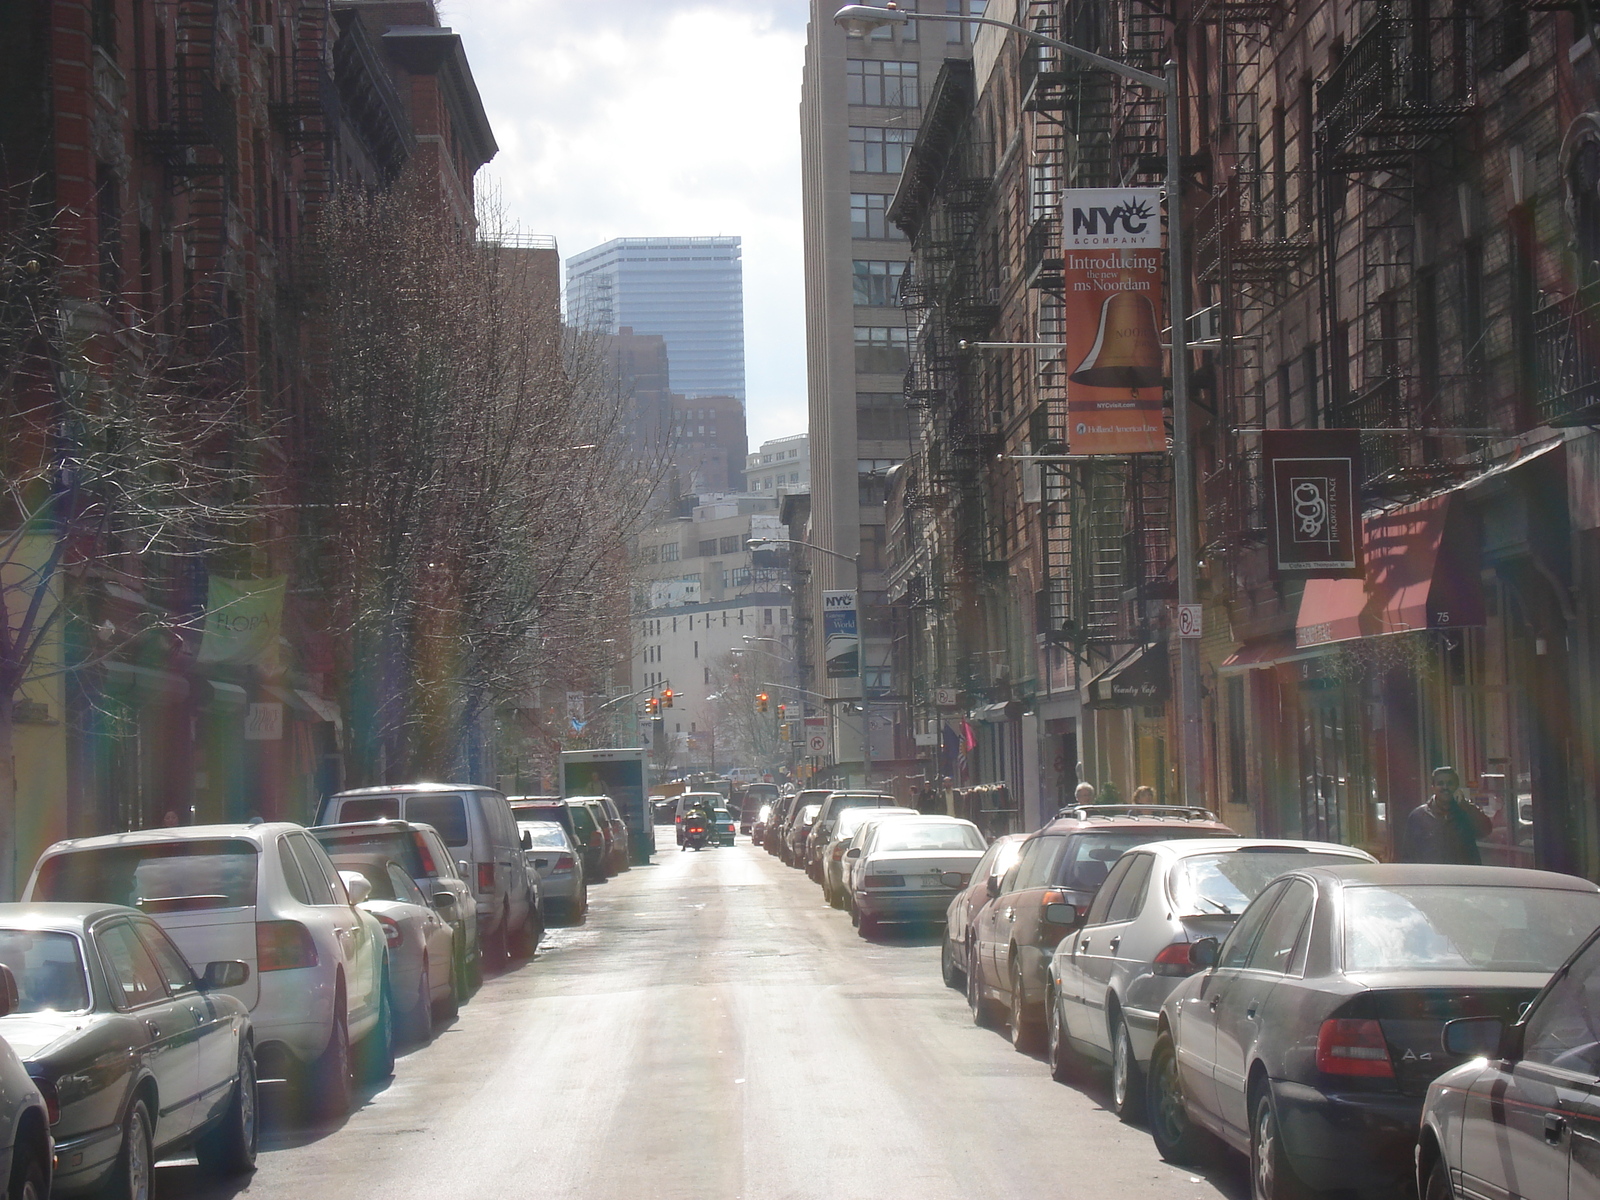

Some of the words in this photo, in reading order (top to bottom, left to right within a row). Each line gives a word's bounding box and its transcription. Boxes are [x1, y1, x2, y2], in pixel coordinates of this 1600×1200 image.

[1073, 195, 1156, 235] NYC
[1083, 237, 1146, 245] COMPANY
[1069, 252, 1157, 274] Introducing
[1087, 270, 1100, 279] the
[1101, 271, 1118, 279] new
[1074, 282, 1091, 291] ms
[1093, 278, 1150, 291] Noordam
[1088, 425, 1113, 433] Holland
[1115, 425, 1142, 433] America
[1143, 424, 1157, 432] Line
[1329, 477, 1337, 502] PLACE
[826, 593, 853, 606] NYC
[1437, 611, 1450, 622] 75
[833, 620, 855, 629] World
[1113, 684, 1139, 697] Country
[1402, 1047, 1433, 1060] A4
